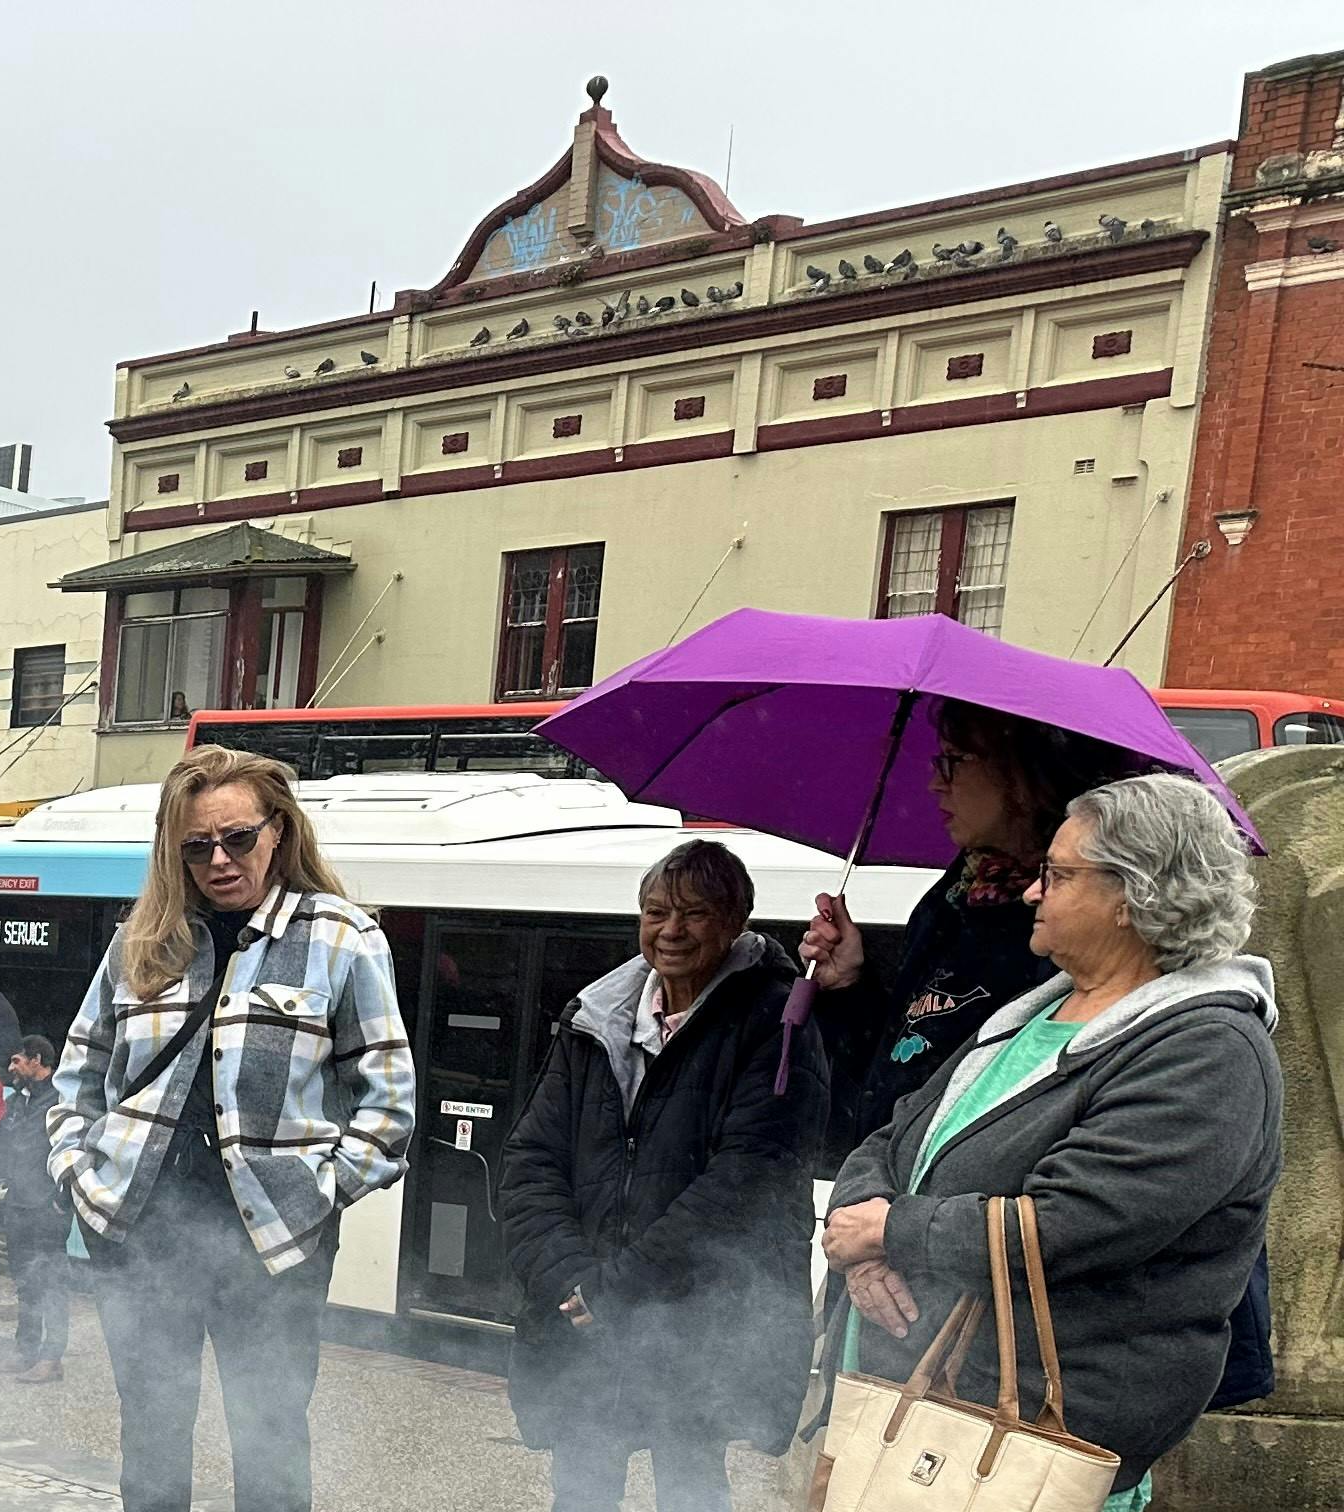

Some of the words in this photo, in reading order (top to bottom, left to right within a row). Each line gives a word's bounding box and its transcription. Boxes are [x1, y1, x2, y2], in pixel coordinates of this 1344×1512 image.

[19, 878, 37, 889] EXIT
[3, 921, 50, 946] SERVICE
[452, 1105, 464, 1113] NO
